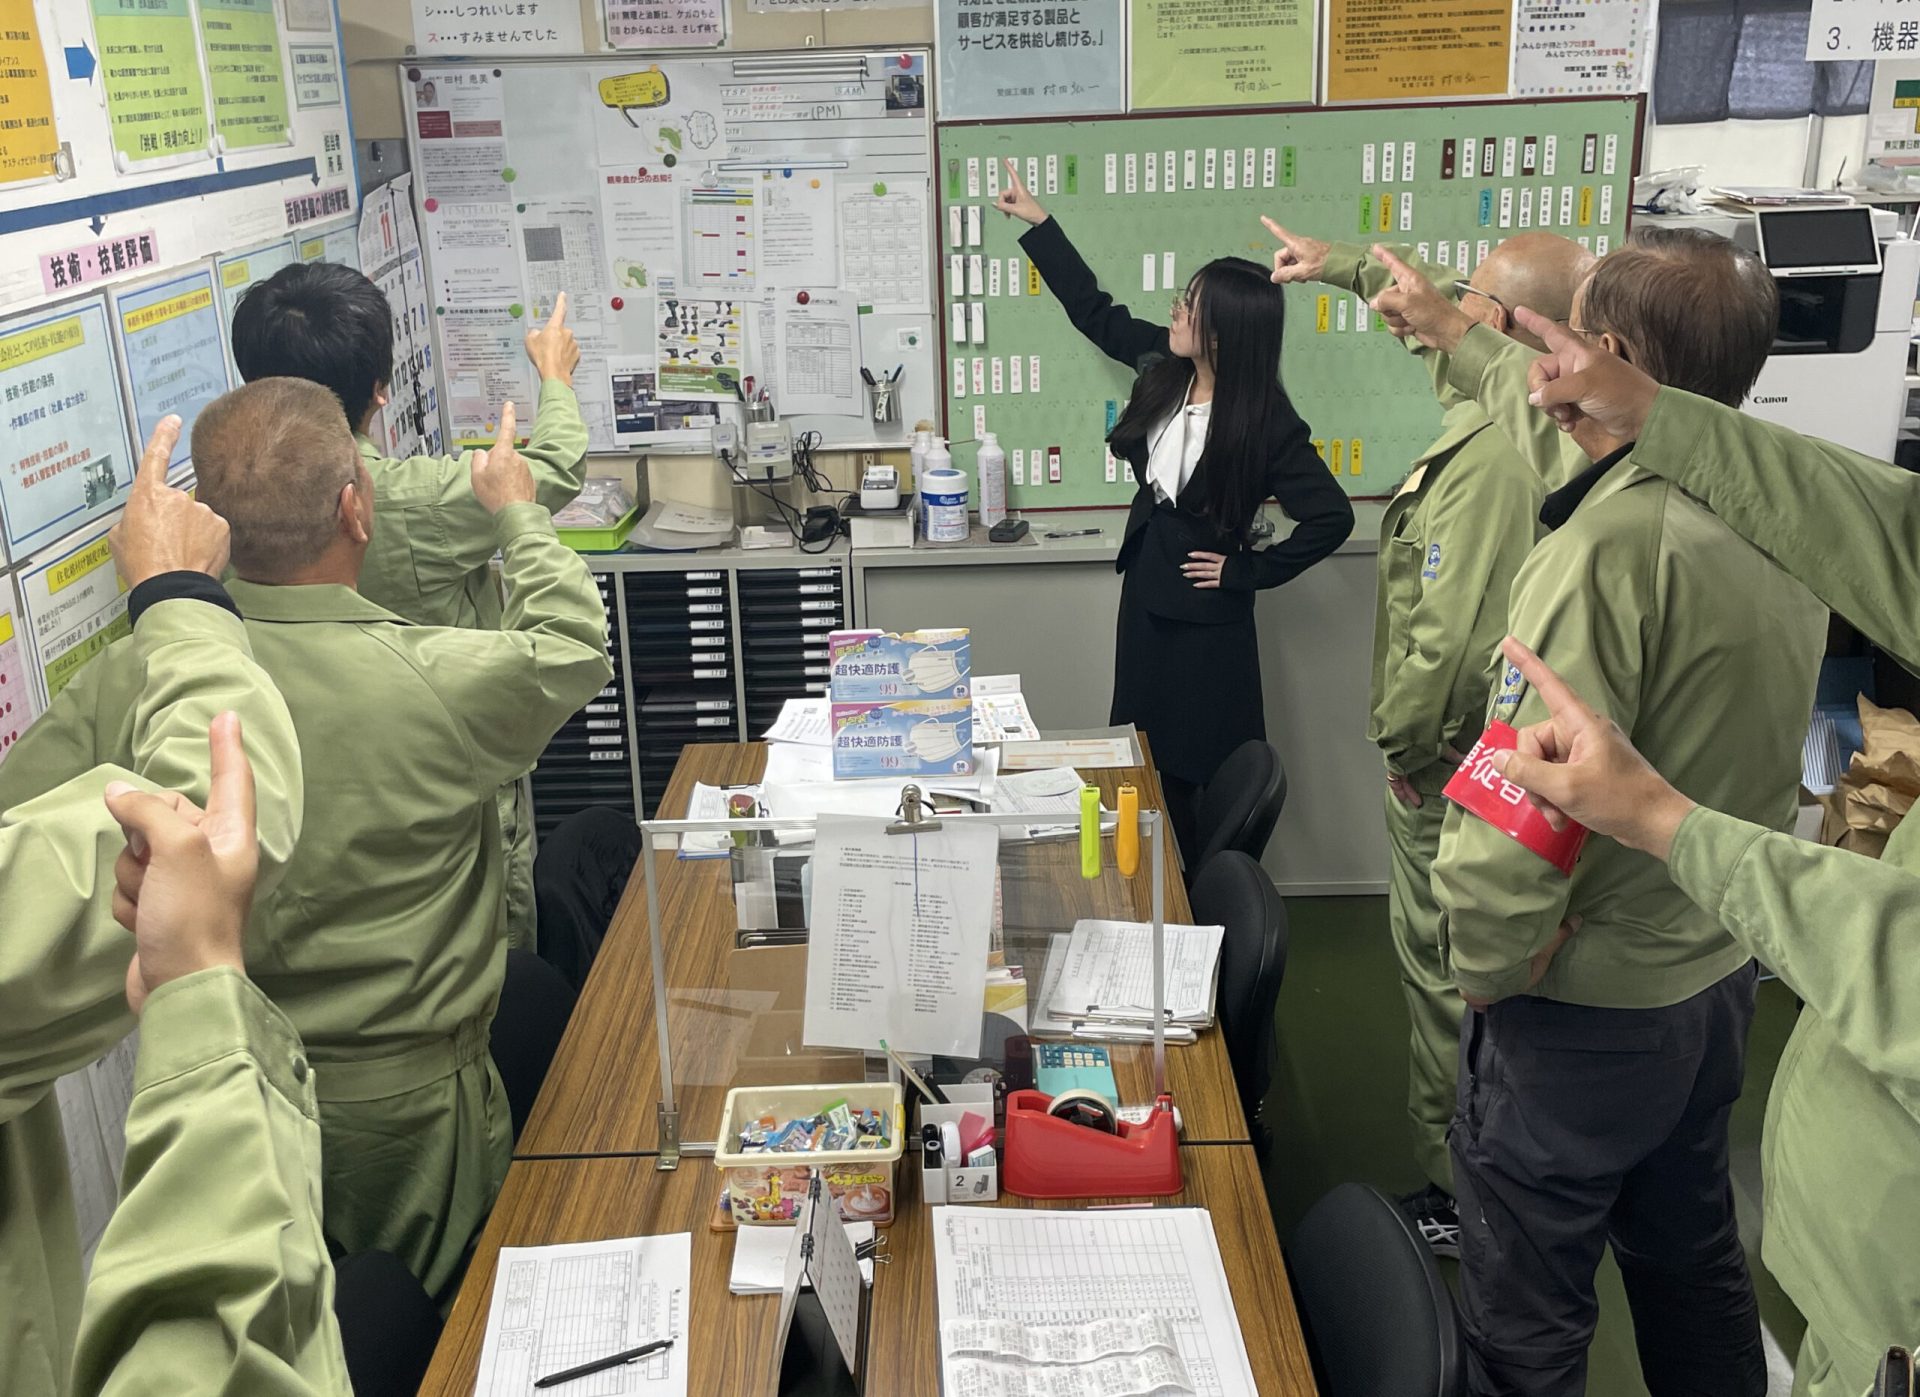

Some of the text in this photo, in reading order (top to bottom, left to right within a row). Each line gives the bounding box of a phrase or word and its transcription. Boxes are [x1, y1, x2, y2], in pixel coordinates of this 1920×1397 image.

[958, 9, 1080, 28] 顧客が満足する製品と
[958, 30, 1104, 51] サービスを供給し続ける。」
[1871, 21, 1919, 52] 機器
[811, 105, 841, 120] (PM)
[380, 212, 392, 250] 11
[50, 235, 154, 289] 技術・技能評価
[1753, 396, 1788, 404] Canon
[835, 662, 900, 676] 超快適防護
[837, 735, 903, 748] 超快適防護
[955, 1176, 965, 1187] 2
